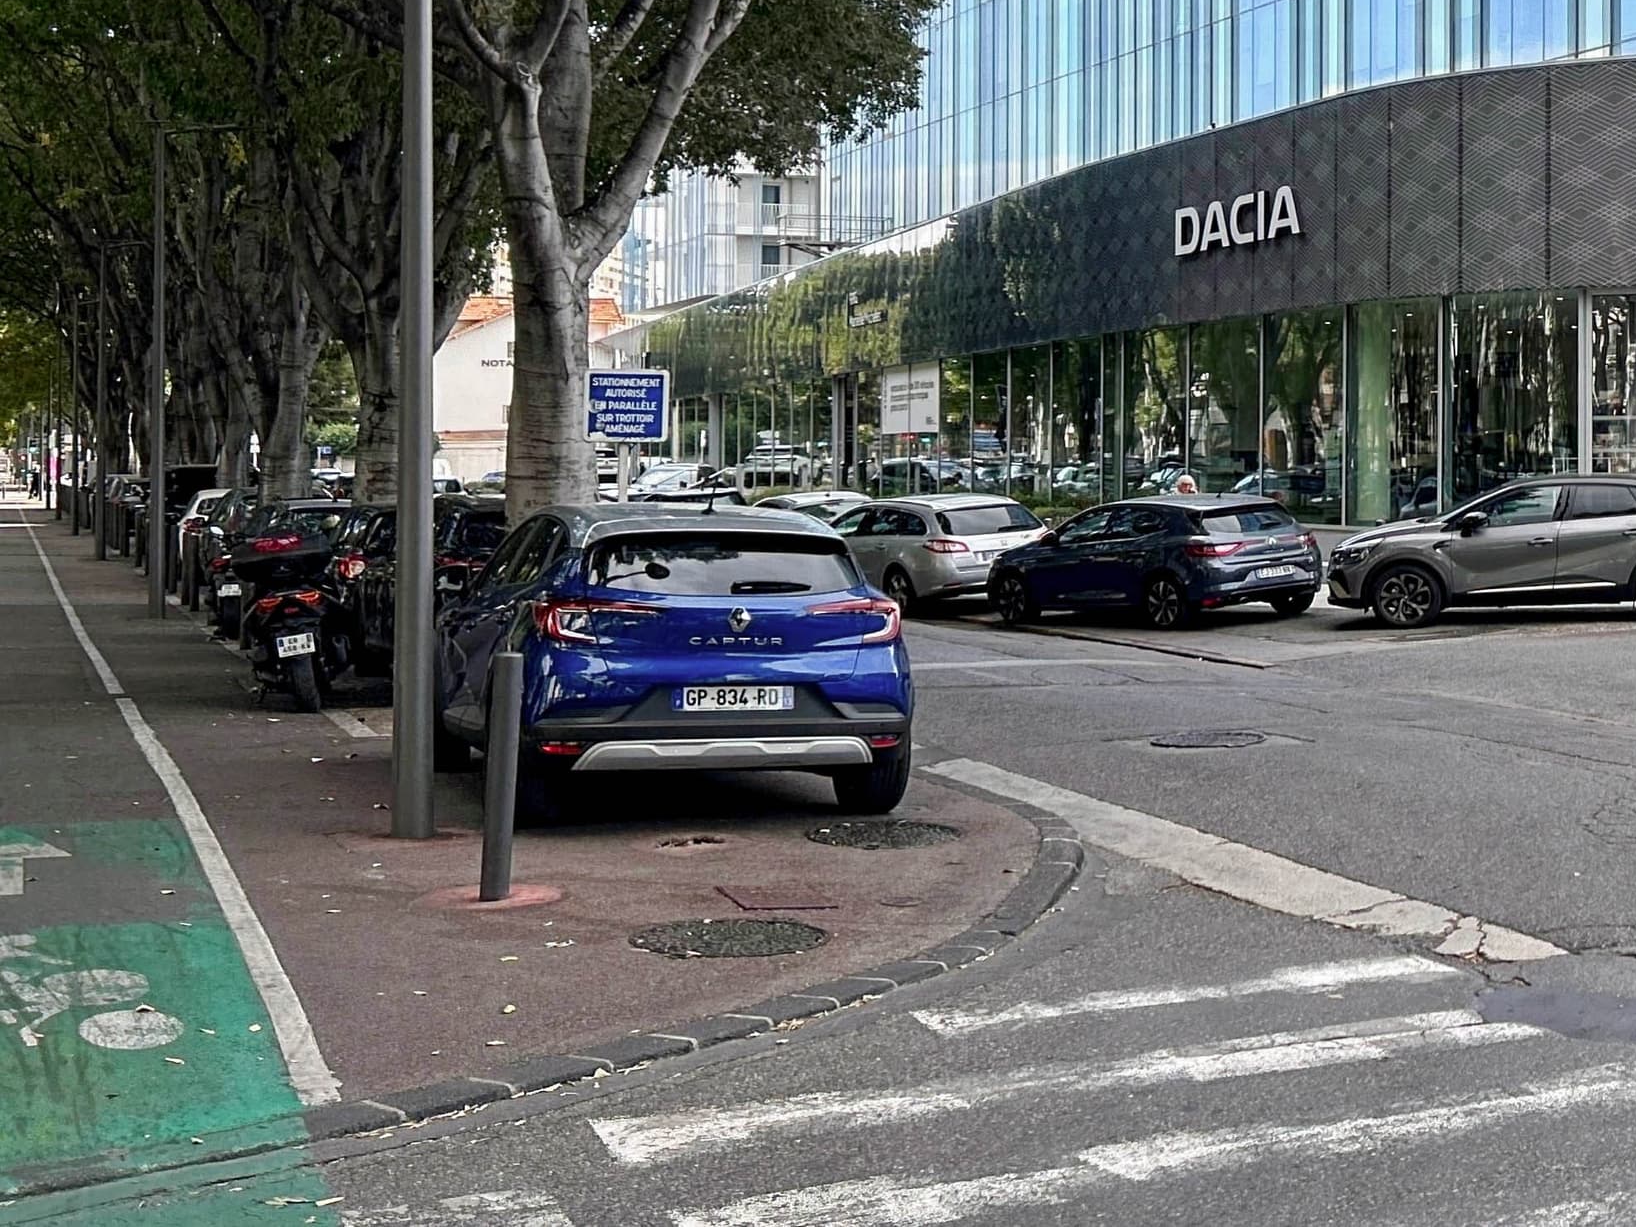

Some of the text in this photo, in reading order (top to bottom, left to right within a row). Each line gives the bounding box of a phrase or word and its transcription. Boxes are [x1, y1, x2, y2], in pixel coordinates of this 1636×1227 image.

[1174, 185, 1301, 256] DACIA
[592, 377, 661, 387] STATIONNEMENT
[594, 400, 607, 410] EN
[596, 413, 655, 423] SUR TROTTOIR
[689, 636, 783, 646] CAPTUR
